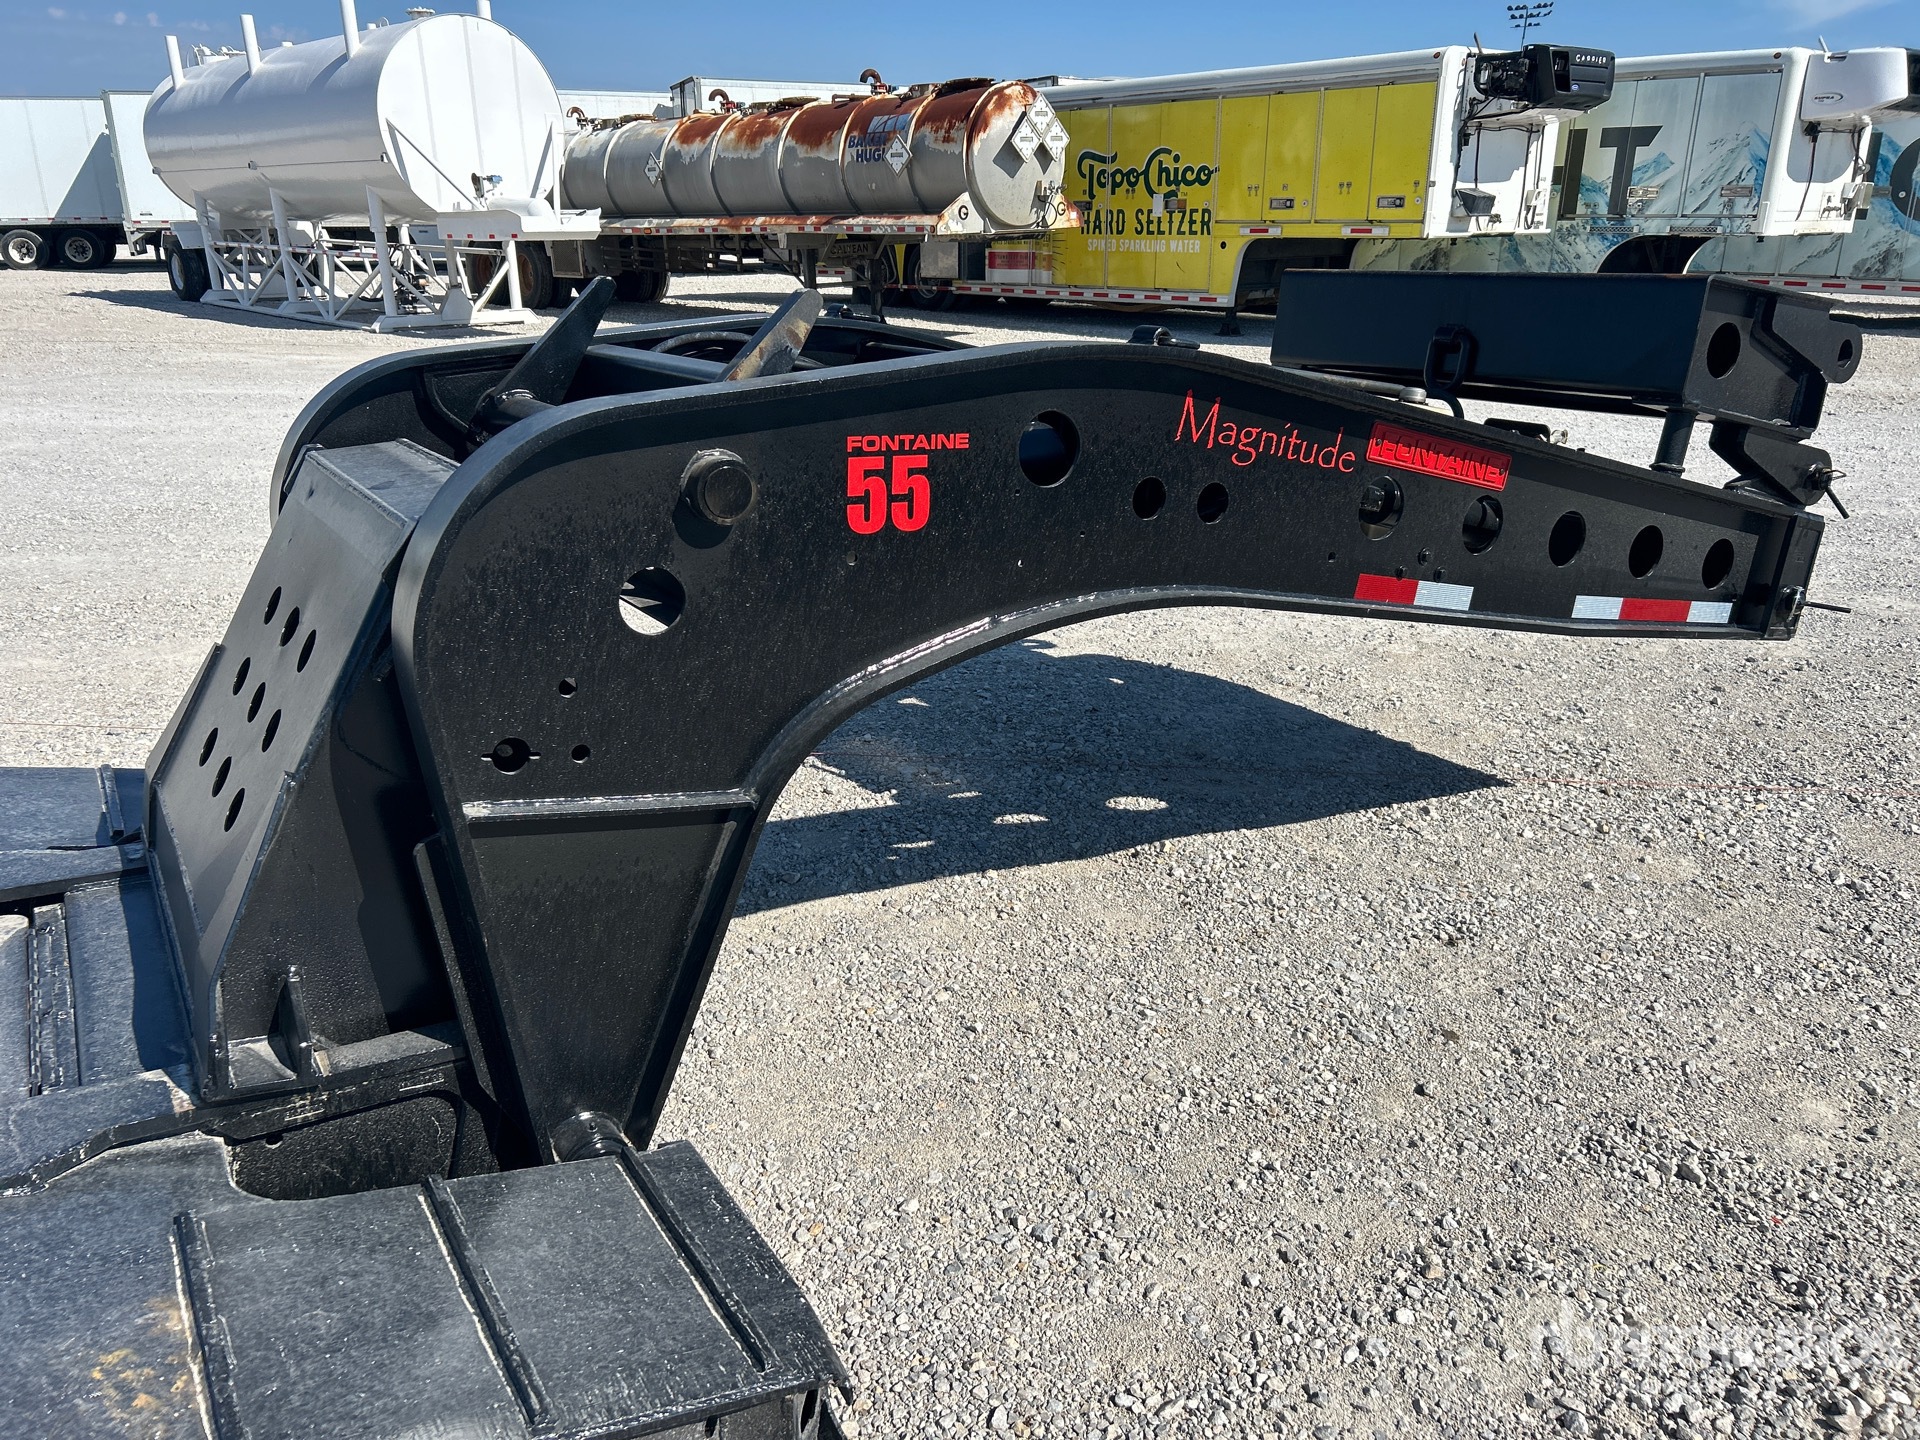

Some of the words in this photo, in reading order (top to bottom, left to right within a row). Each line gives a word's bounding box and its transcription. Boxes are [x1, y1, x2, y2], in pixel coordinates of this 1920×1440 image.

[1077, 150, 1140, 200] Topo
[1143, 146, 1219, 201] Chico
[1081, 208, 1126, 235] HARD
[1134, 208, 1212, 236] SELTZER
[1087, 239, 1116, 252] SPIKED
[1119, 239, 1166, 253] SPARKLING
[1169, 239, 1200, 253] WATER
[846, 433, 970, 453] FONTAINE
[1174, 388, 1356, 473] Magnitude
[1379, 430, 1506, 484] FONTAINE
[846, 454, 931, 535] 55
